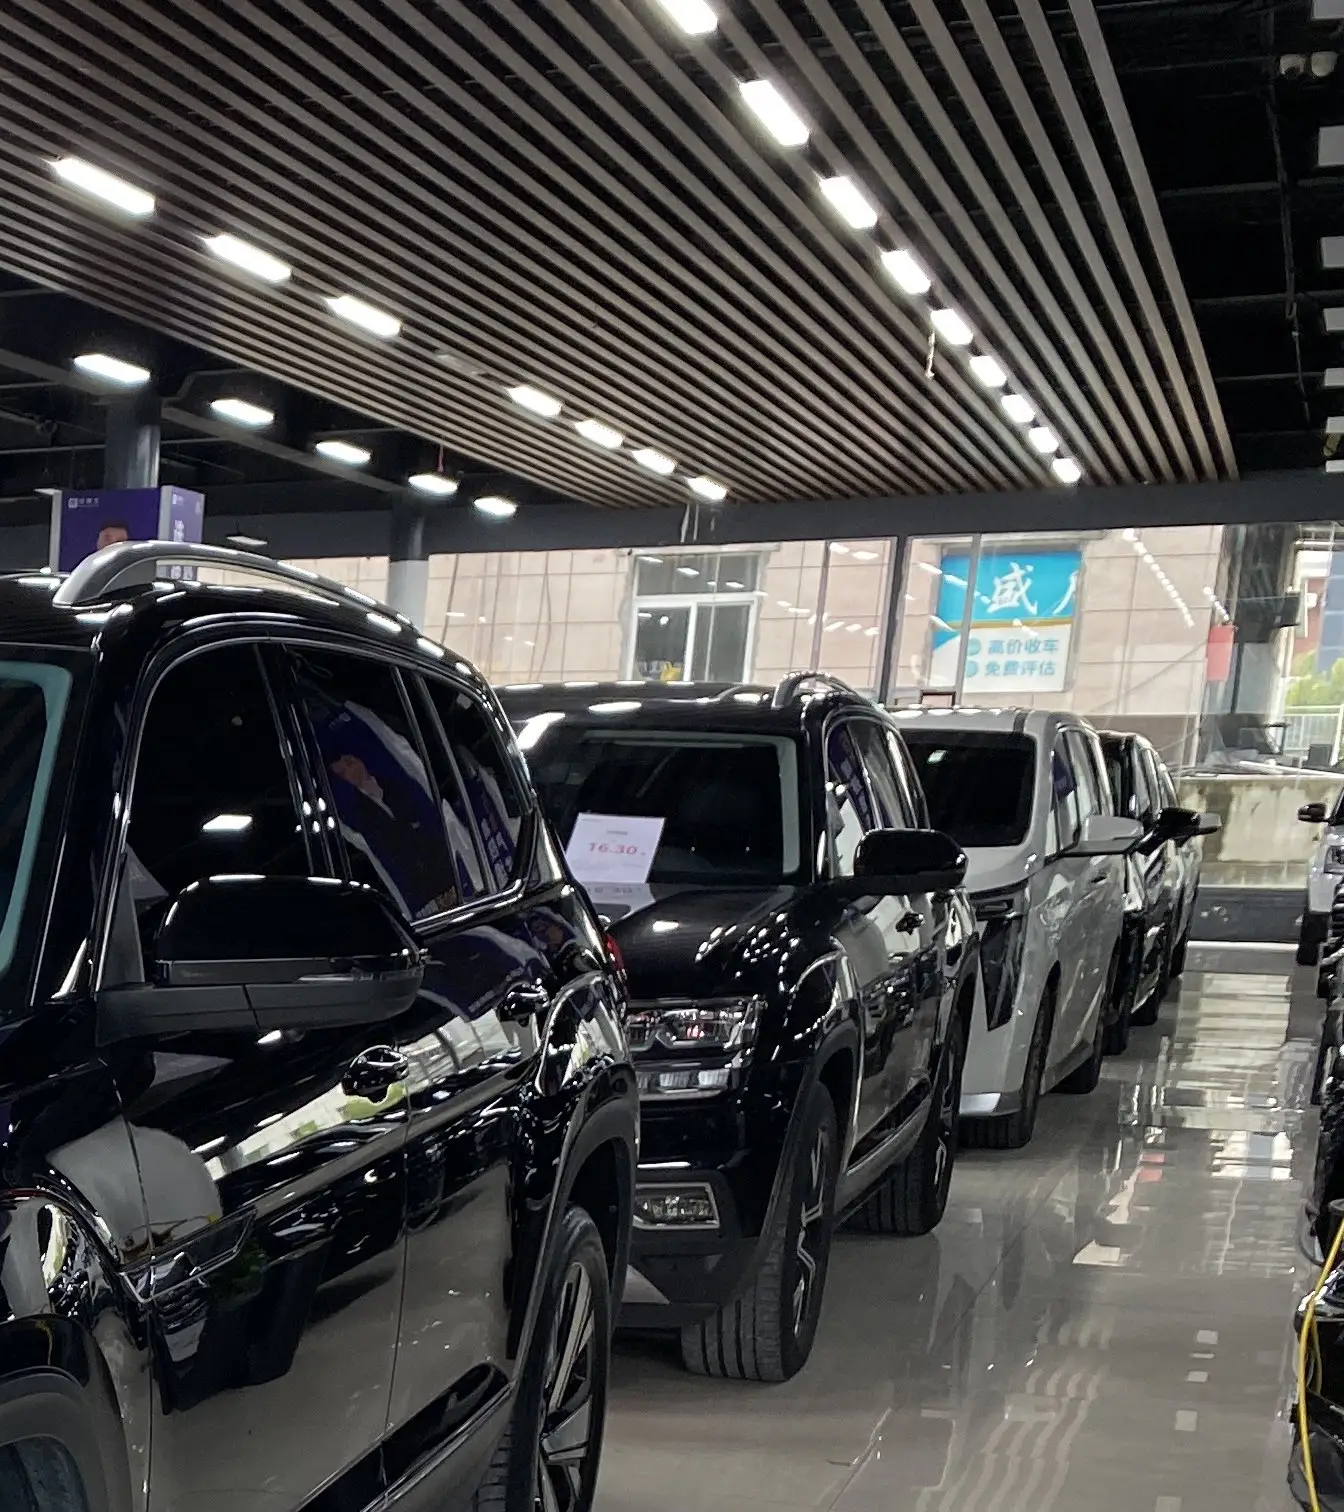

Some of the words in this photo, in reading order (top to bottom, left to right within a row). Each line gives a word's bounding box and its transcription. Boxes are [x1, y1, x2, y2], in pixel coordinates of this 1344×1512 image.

[987, 638, 1060, 655] 高价收车
[983, 660, 1057, 677] 免费评估
[588, 841, 639, 856] 16.30
